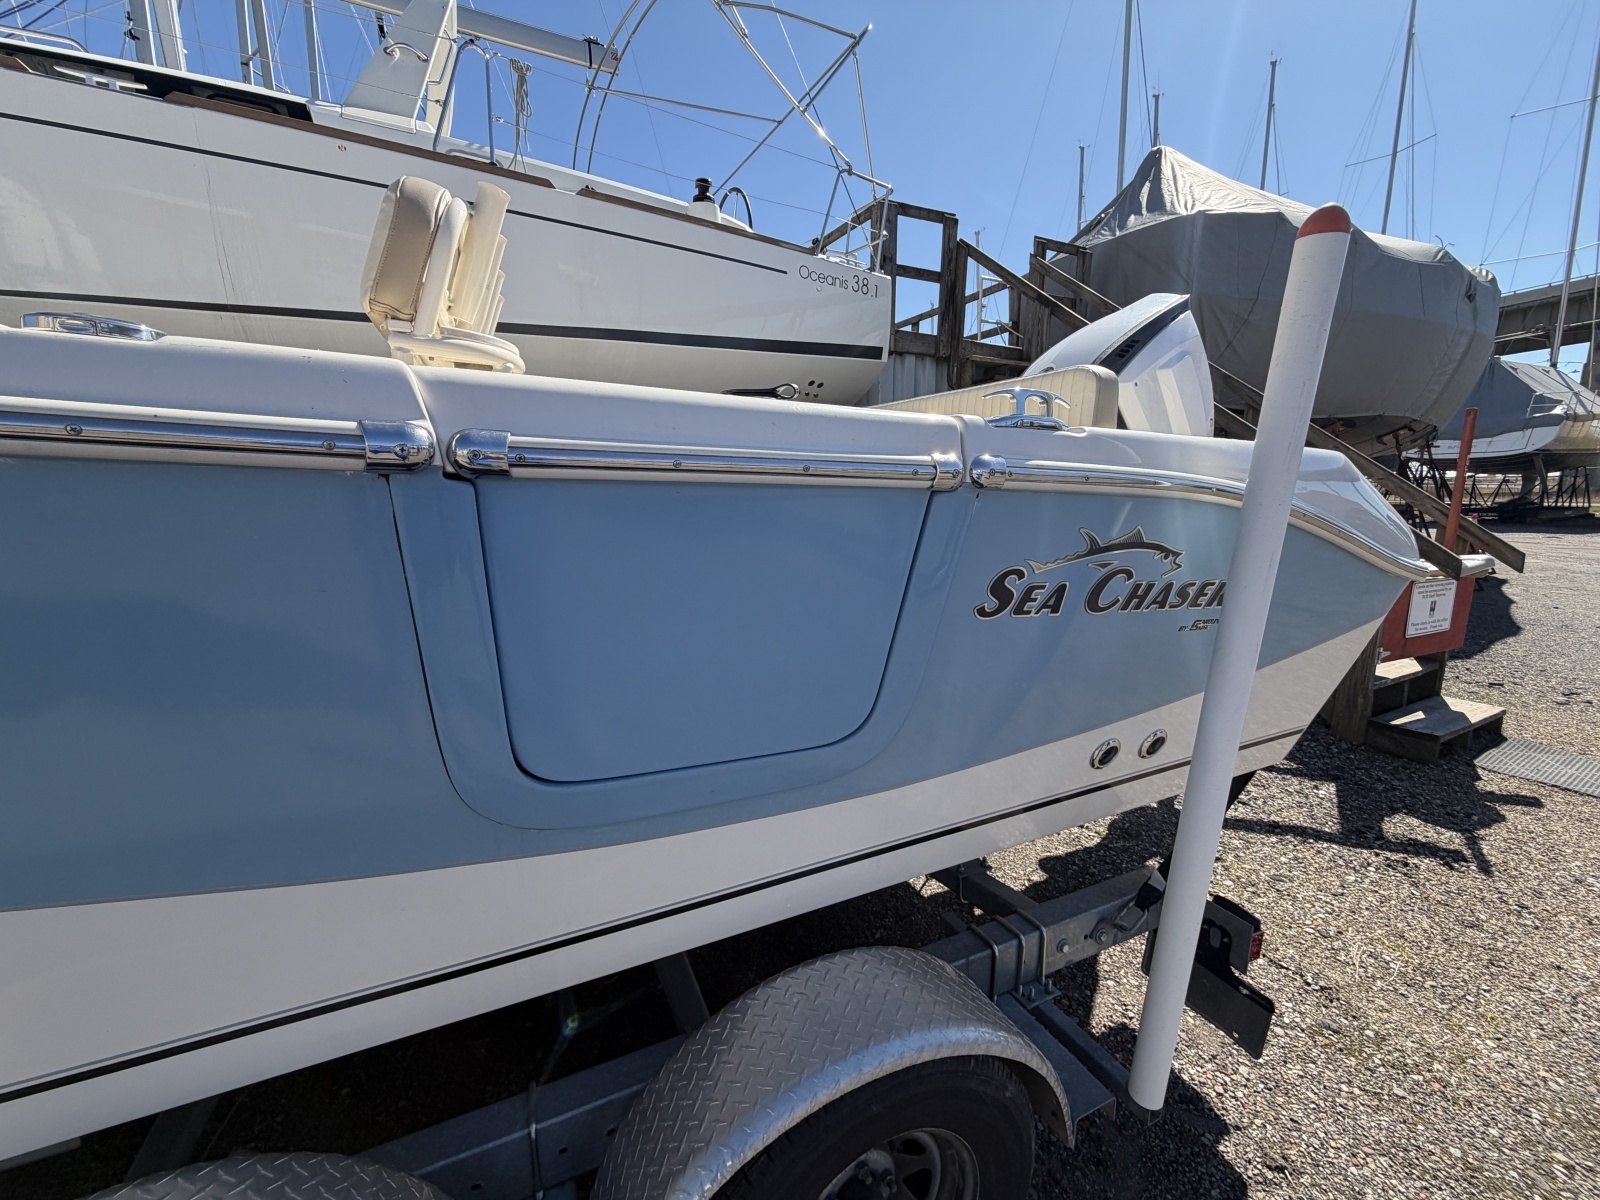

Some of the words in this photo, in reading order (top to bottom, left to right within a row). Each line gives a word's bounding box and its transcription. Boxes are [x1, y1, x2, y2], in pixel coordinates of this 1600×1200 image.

[799, 265, 848, 290] Oceanis
[852, 275, 878, 298] 38.1
[974, 566, 1069, 620] SEA
